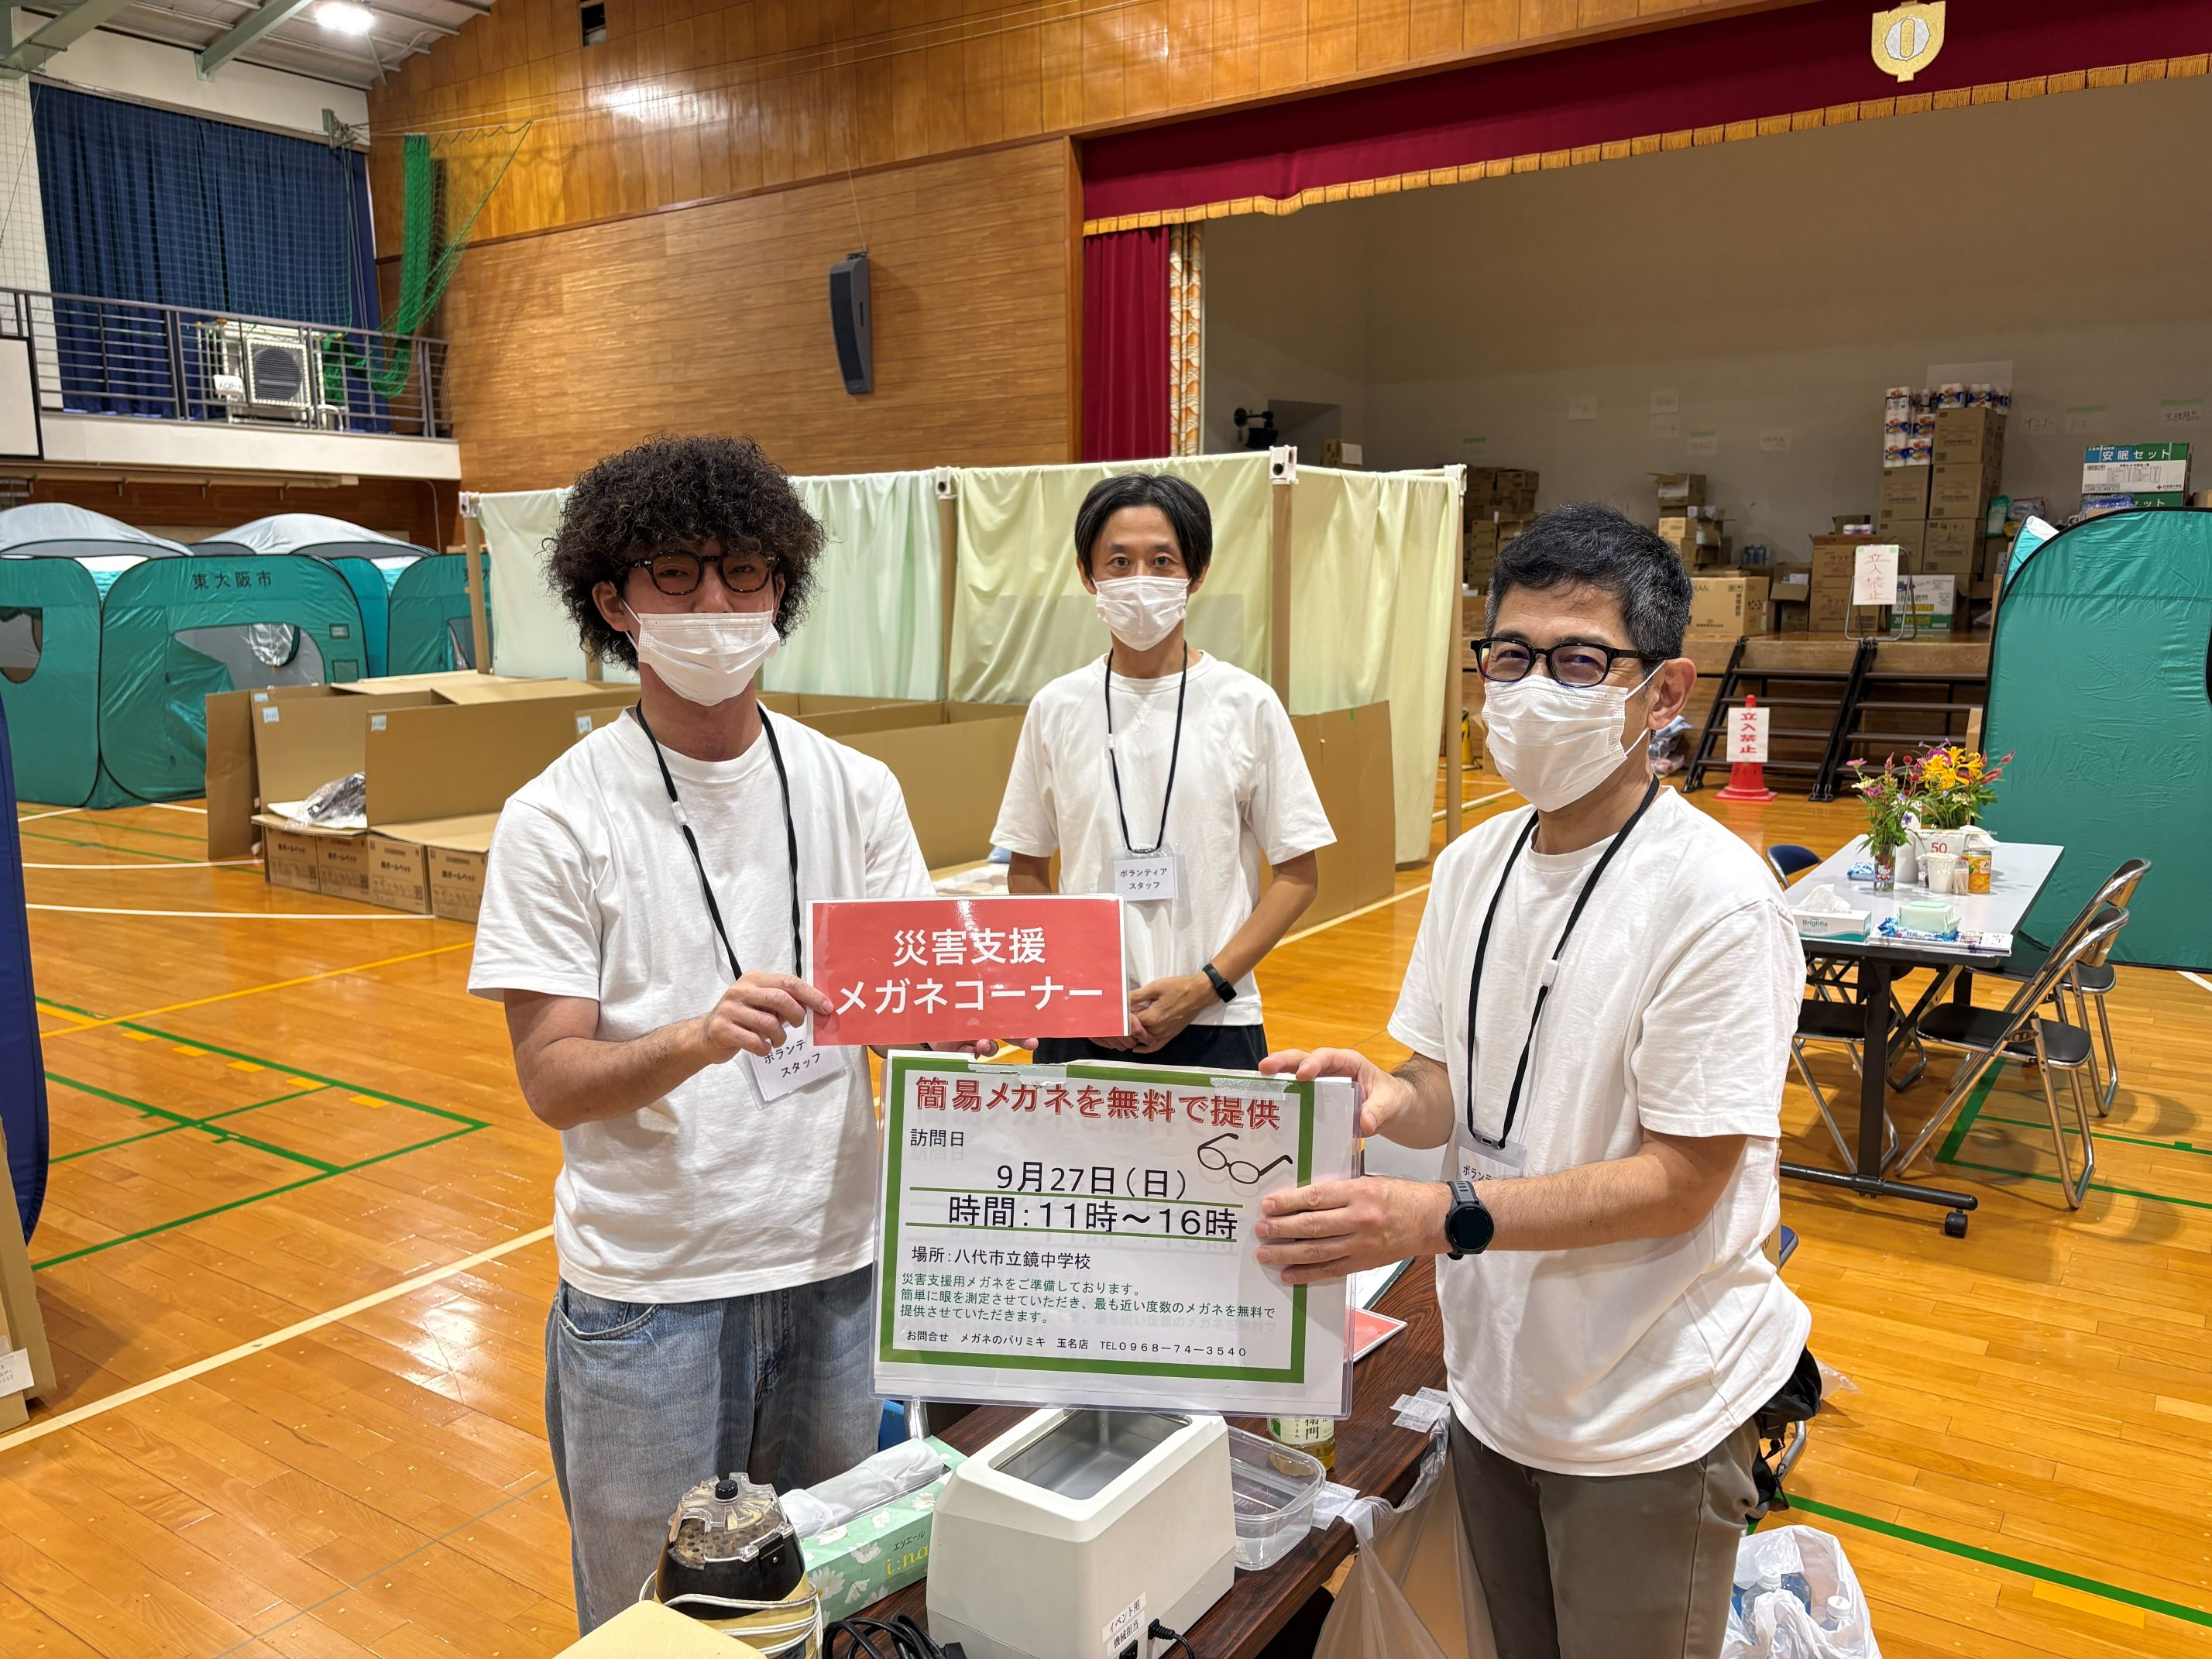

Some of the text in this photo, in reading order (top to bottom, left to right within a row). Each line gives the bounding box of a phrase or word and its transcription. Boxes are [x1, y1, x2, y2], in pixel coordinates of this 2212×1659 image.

[2101, 448, 2170, 462] 安眠セット
[193, 571, 272, 589] 東大阪市
[1865, 552, 1891, 600] 立入禁止
[1740, 713, 1757, 754] 立入禁止
[1931, 842, 1948, 853] 50
[1120, 868, 1167, 878] ボランティア
[1129, 881, 1160, 890] スタッフ
[892, 926, 1046, 967] 災害支援
[834, 976, 1103, 1015] メガネコーナー
[764, 1039, 805, 1064] ボランテ
[781, 1053, 820, 1078] スタッフ
[915, 1076, 1281, 1131] 簡易メガネを無料で提供
[910, 1128, 964, 1148] 訪問日
[996, 1161, 1186, 1200] 9月27日（日）
[912, 1245, 1091, 1269] 場所:八代市立鏡中学校
[902, 1272, 1139, 1297] 災害支援用メガネをご準備しております。
[900, 1304, 1047, 1324] 提供させていただきます。
[901, 1288, 1276, 1319] 簡単に眼を測定させていただき、最も近い度数のメガネを無料で
[907, 1330, 950, 1343] お問合せ
[960, 1332, 1046, 1346] メガネのパリミキ
[1056, 1338, 1089, 1349] 玉名店
[892, 1530, 926, 1551] エリエール
[1109, 1599, 1140, 1633] イベント用
[1114, 1619, 1139, 1649] 機械担当
